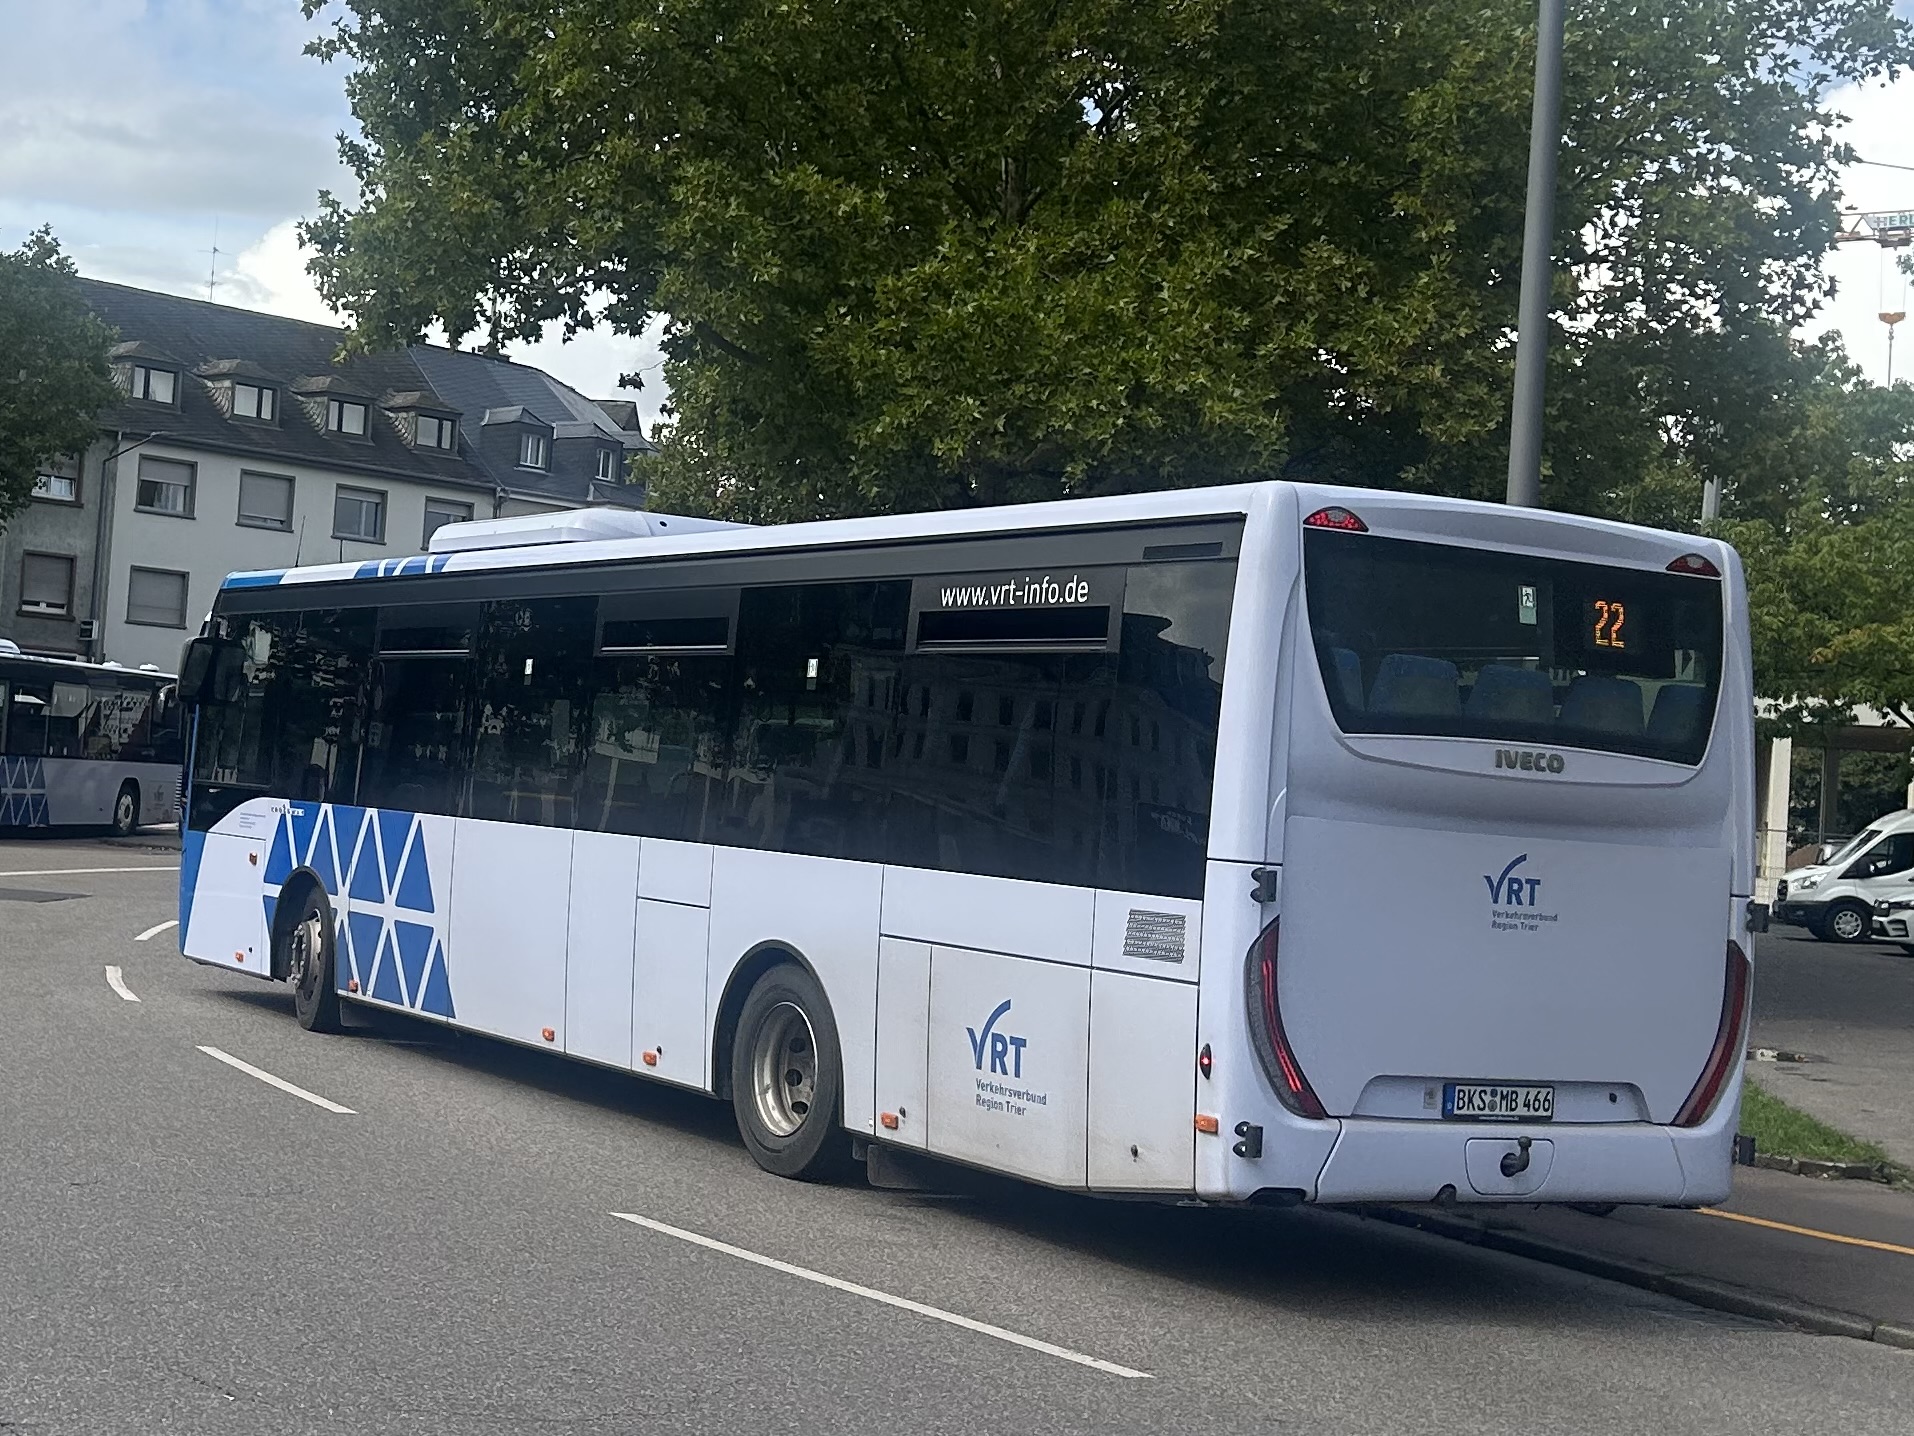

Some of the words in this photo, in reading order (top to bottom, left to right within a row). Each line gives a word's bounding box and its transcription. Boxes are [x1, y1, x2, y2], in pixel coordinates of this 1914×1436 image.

[941, 575, 1089, 607] www.vrt-info.de
[1594, 600, 1625, 648] 22
[1495, 749, 1565, 774] IVECO
[1483, 853, 1541, 907] VRT
[1491, 920, 1518, 931] Region
[1520, 921, 1539, 931] Trier
[1492, 909, 1558, 922] Verkehrsverbund
[966, 999, 1027, 1078] VRT
[975, 1078, 1047, 1105] Verkehrsverbund
[1456, 1088, 1488, 1111] BKS
[1499, 1089, 1519, 1112] MB
[1523, 1090, 1551, 1112] 466
[975, 1094, 1004, 1112] Region
[1005, 1101, 1027, 1116] Trier
